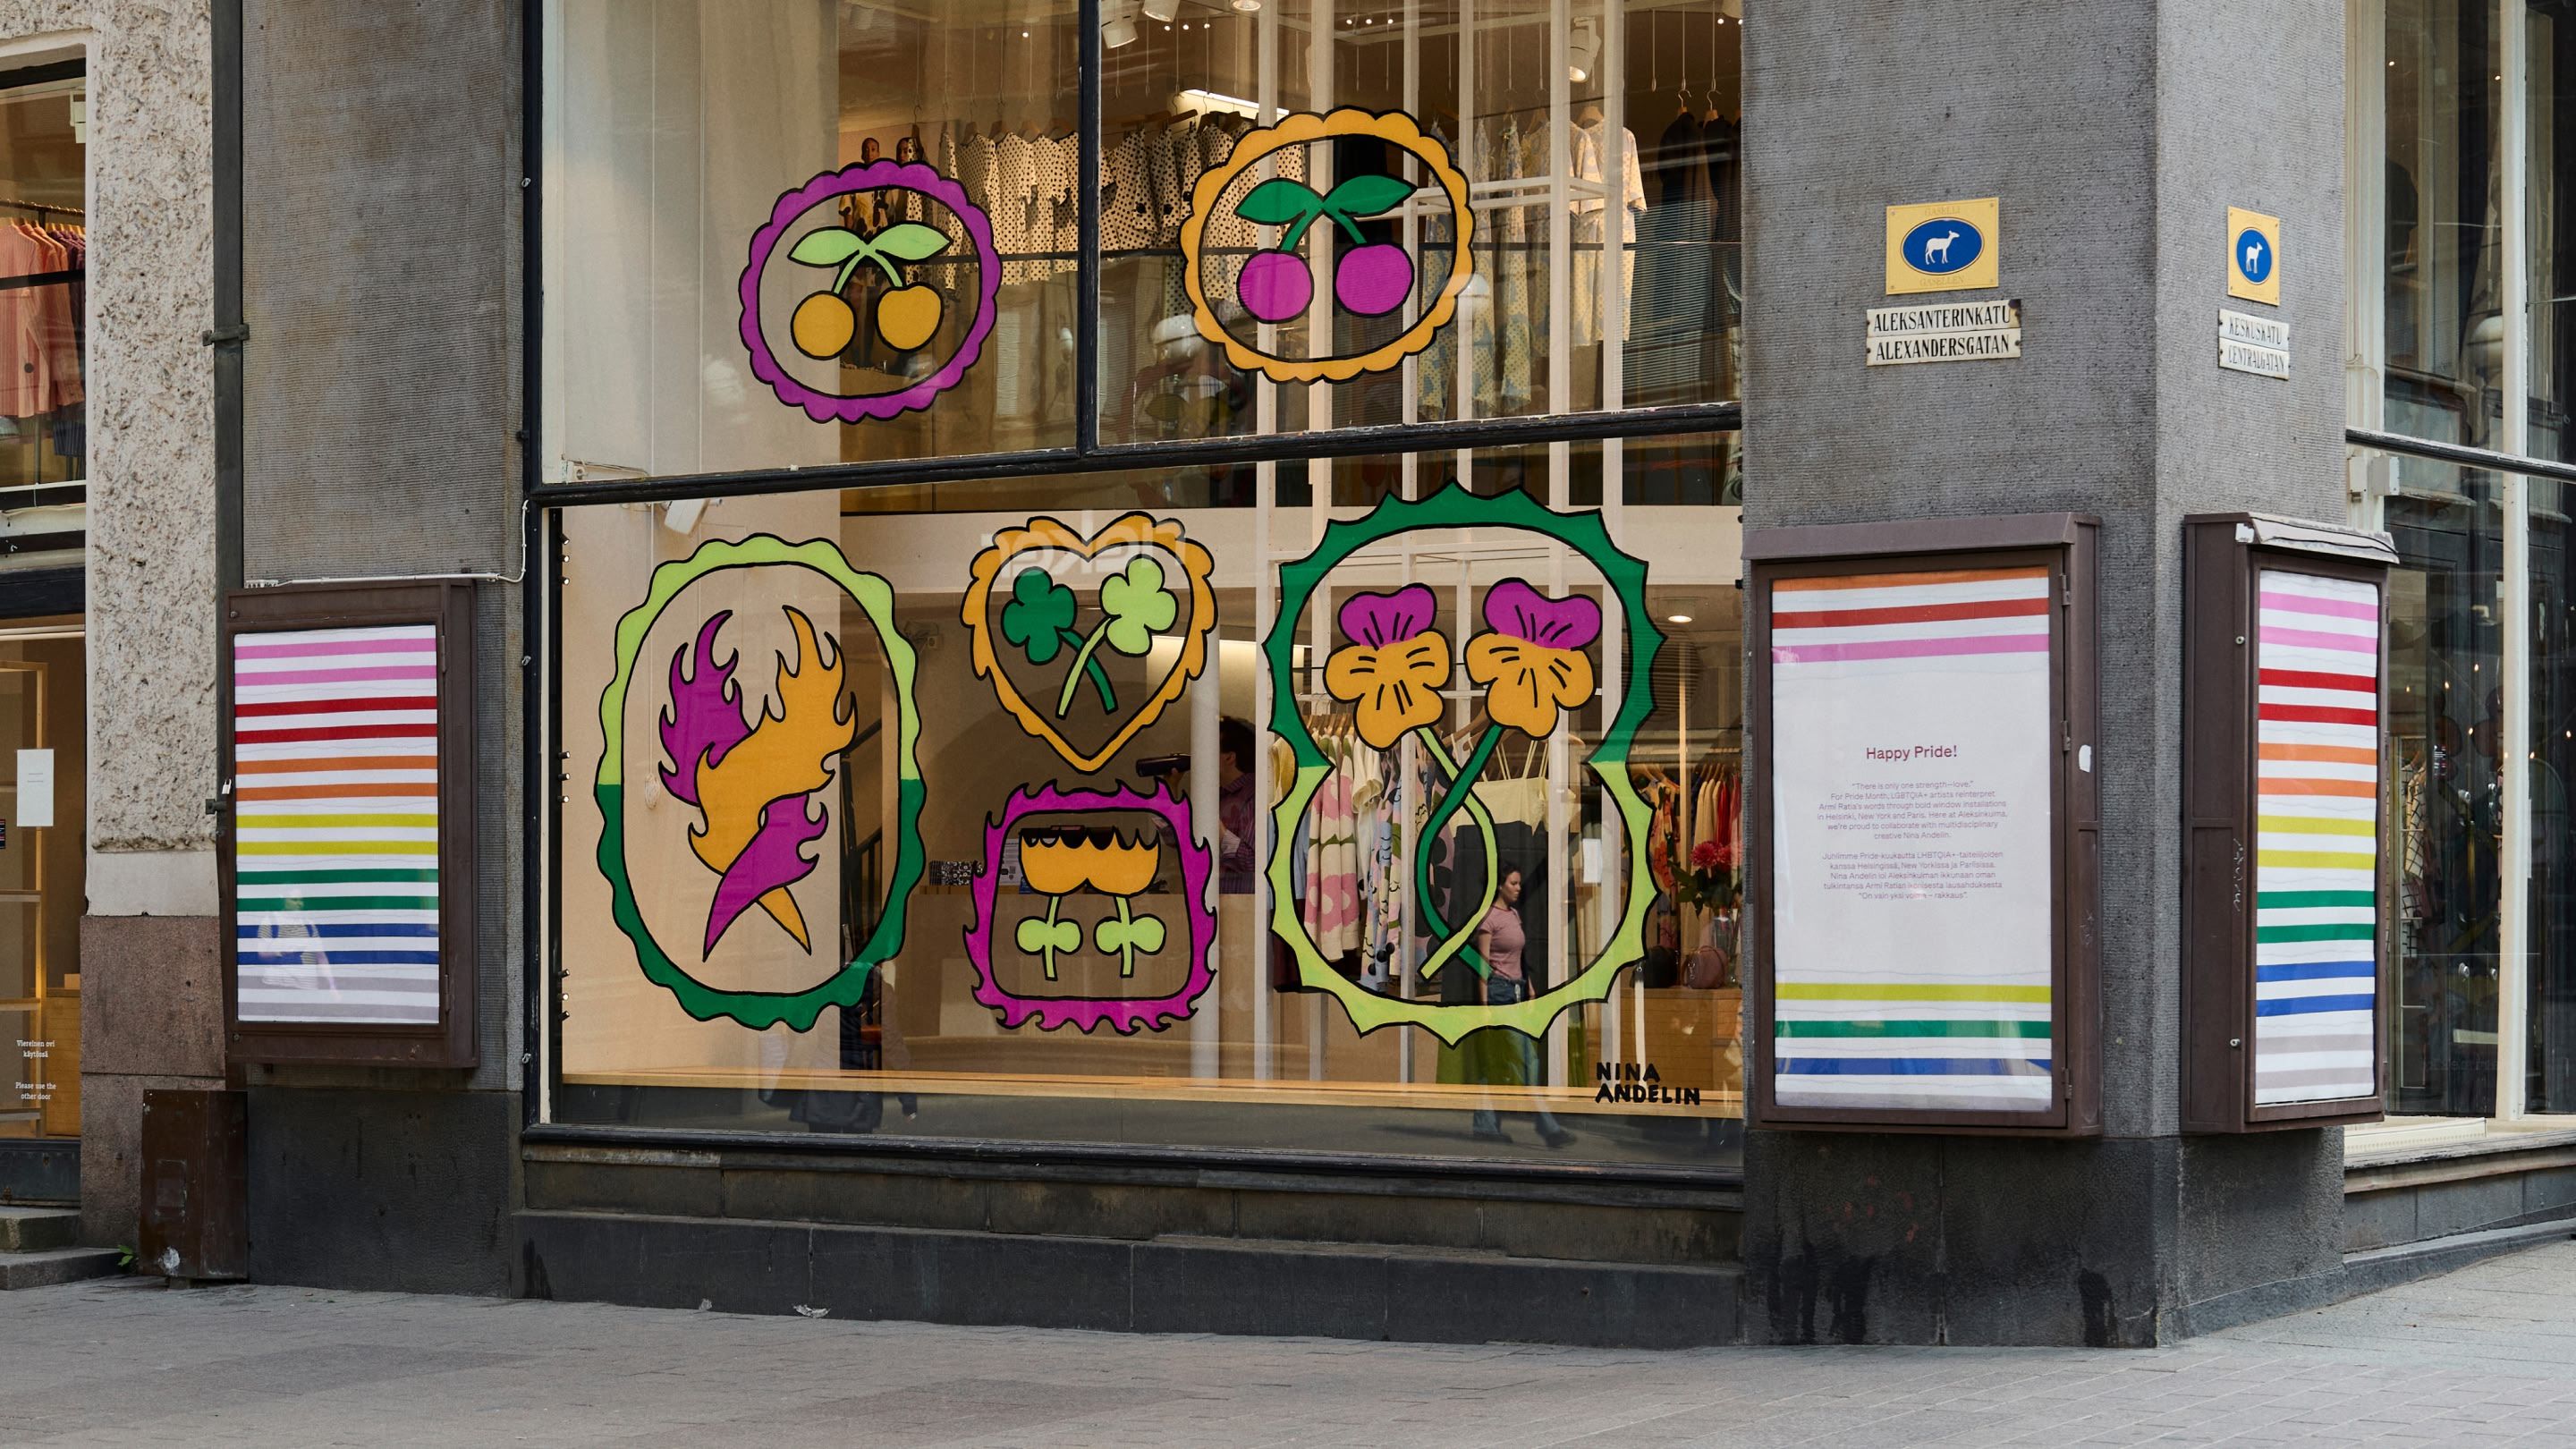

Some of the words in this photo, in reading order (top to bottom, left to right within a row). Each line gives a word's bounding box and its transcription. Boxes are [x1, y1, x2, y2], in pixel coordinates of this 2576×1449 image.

[1873, 305, 2011, 333] ALEKSANTERINKATU
[2229, 317, 2283, 344] KESKUSKATU
[1876, 334, 2010, 360] ALEXANDERSGATAN
[2228, 345, 2284, 372] CENTRALGATAN
[1866, 747, 1911, 762] Happy
[1914, 745, 1957, 758] Pride!
[1596, 1062, 1661, 1082] NINA
[1595, 1083, 1700, 1105] ANDELIN
